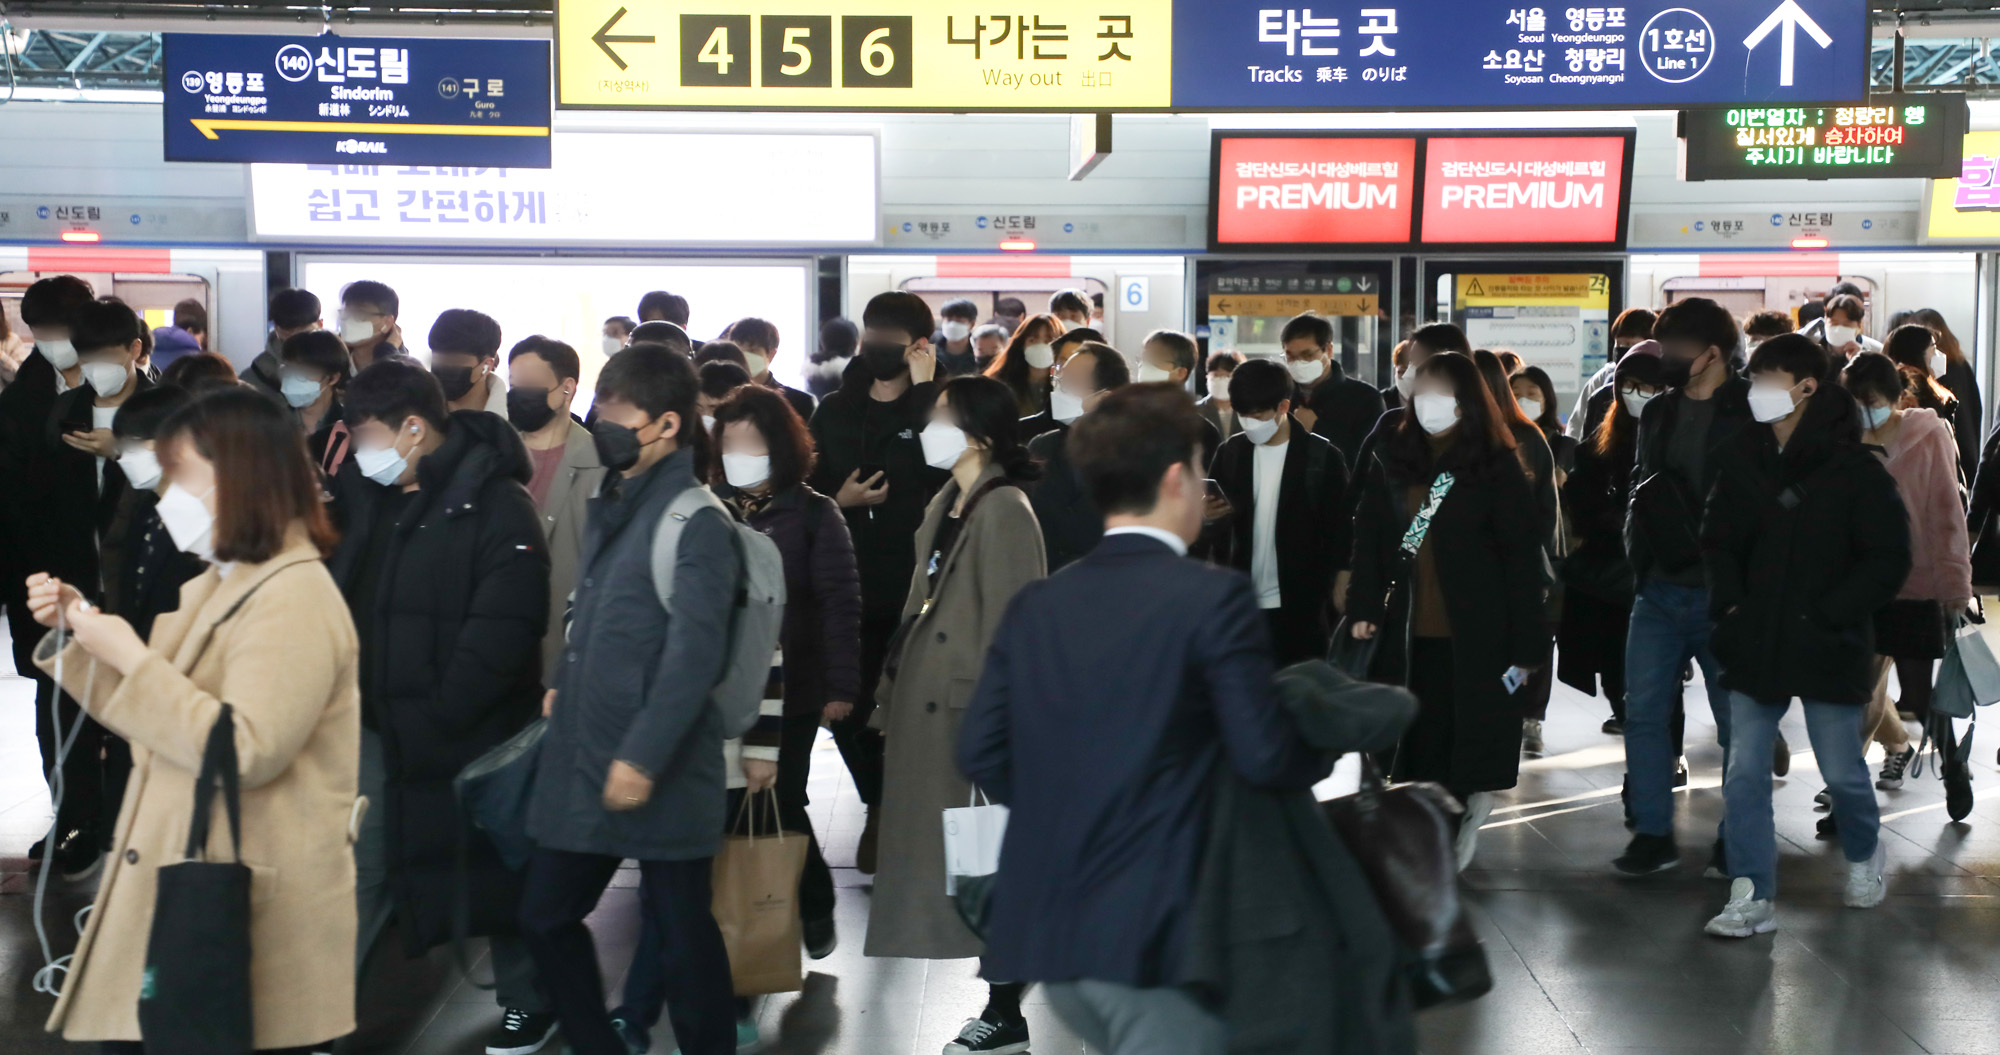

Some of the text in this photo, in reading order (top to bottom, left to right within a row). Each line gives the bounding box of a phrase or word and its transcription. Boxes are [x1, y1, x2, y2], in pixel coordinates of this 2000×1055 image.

[1505, 7, 1626, 32] 서울 영등포
[947, 15, 1134, 61] 나가는 곳
[1258, 8, 1398, 57] 타는 곳
[1518, 33, 1625, 45] Seoul Yeongdeungpo
[1648, 28, 1706, 53] 1호선
[697, 26, 734, 75] 4
[780, 27, 812, 76] 5
[860, 27, 895, 76] 6
[281, 46, 409, 84] 140 신도림
[1482, 48, 1625, 73] 소요산 청량리
[1657, 57, 1697, 70] Line 1
[185, 71, 265, 95] 139 영등포
[982, 68, 1062, 90] Way out
[1081, 69, 1112, 88] 出口
[1247, 65, 1303, 83] Tracks
[1362, 66, 1407, 82] のりば
[1504, 73, 1624, 86] Soyosan Cheongnyangni
[331, 85, 394, 101] Sindorim
[442, 78, 504, 99] 141 구로
[598, 80, 649, 93] (지상역사)
[204, 94, 268, 106] Yeongdeungpo
[475, 101, 495, 109] Guro
[1905, 106, 1925, 125] 행
[1736, 127, 1903, 146] 질서있게 승차하여
[336, 138, 388, 155] KORAIL
[1746, 146, 1894, 165] 주시기 바랍니다
[1236, 161, 1399, 178] 검단신도시 대성베르힐
[1441, 160, 1606, 177] 검단신도시 대성베르힐
[1236, 182, 1398, 210] PREMIUM
[1441, 181, 1604, 209] PREMIUM
[56, 206, 100, 220] 신도림
[308, 189, 380, 222] 쉽고
[397, 189, 546, 225] 간편하게
[918, 222, 951, 233] 영등포
[993, 216, 1036, 229] 신도림
[1711, 221, 1744, 232] 영등포
[1789, 213, 1832, 227] 신도림
[1127, 282, 1142, 305] 6
